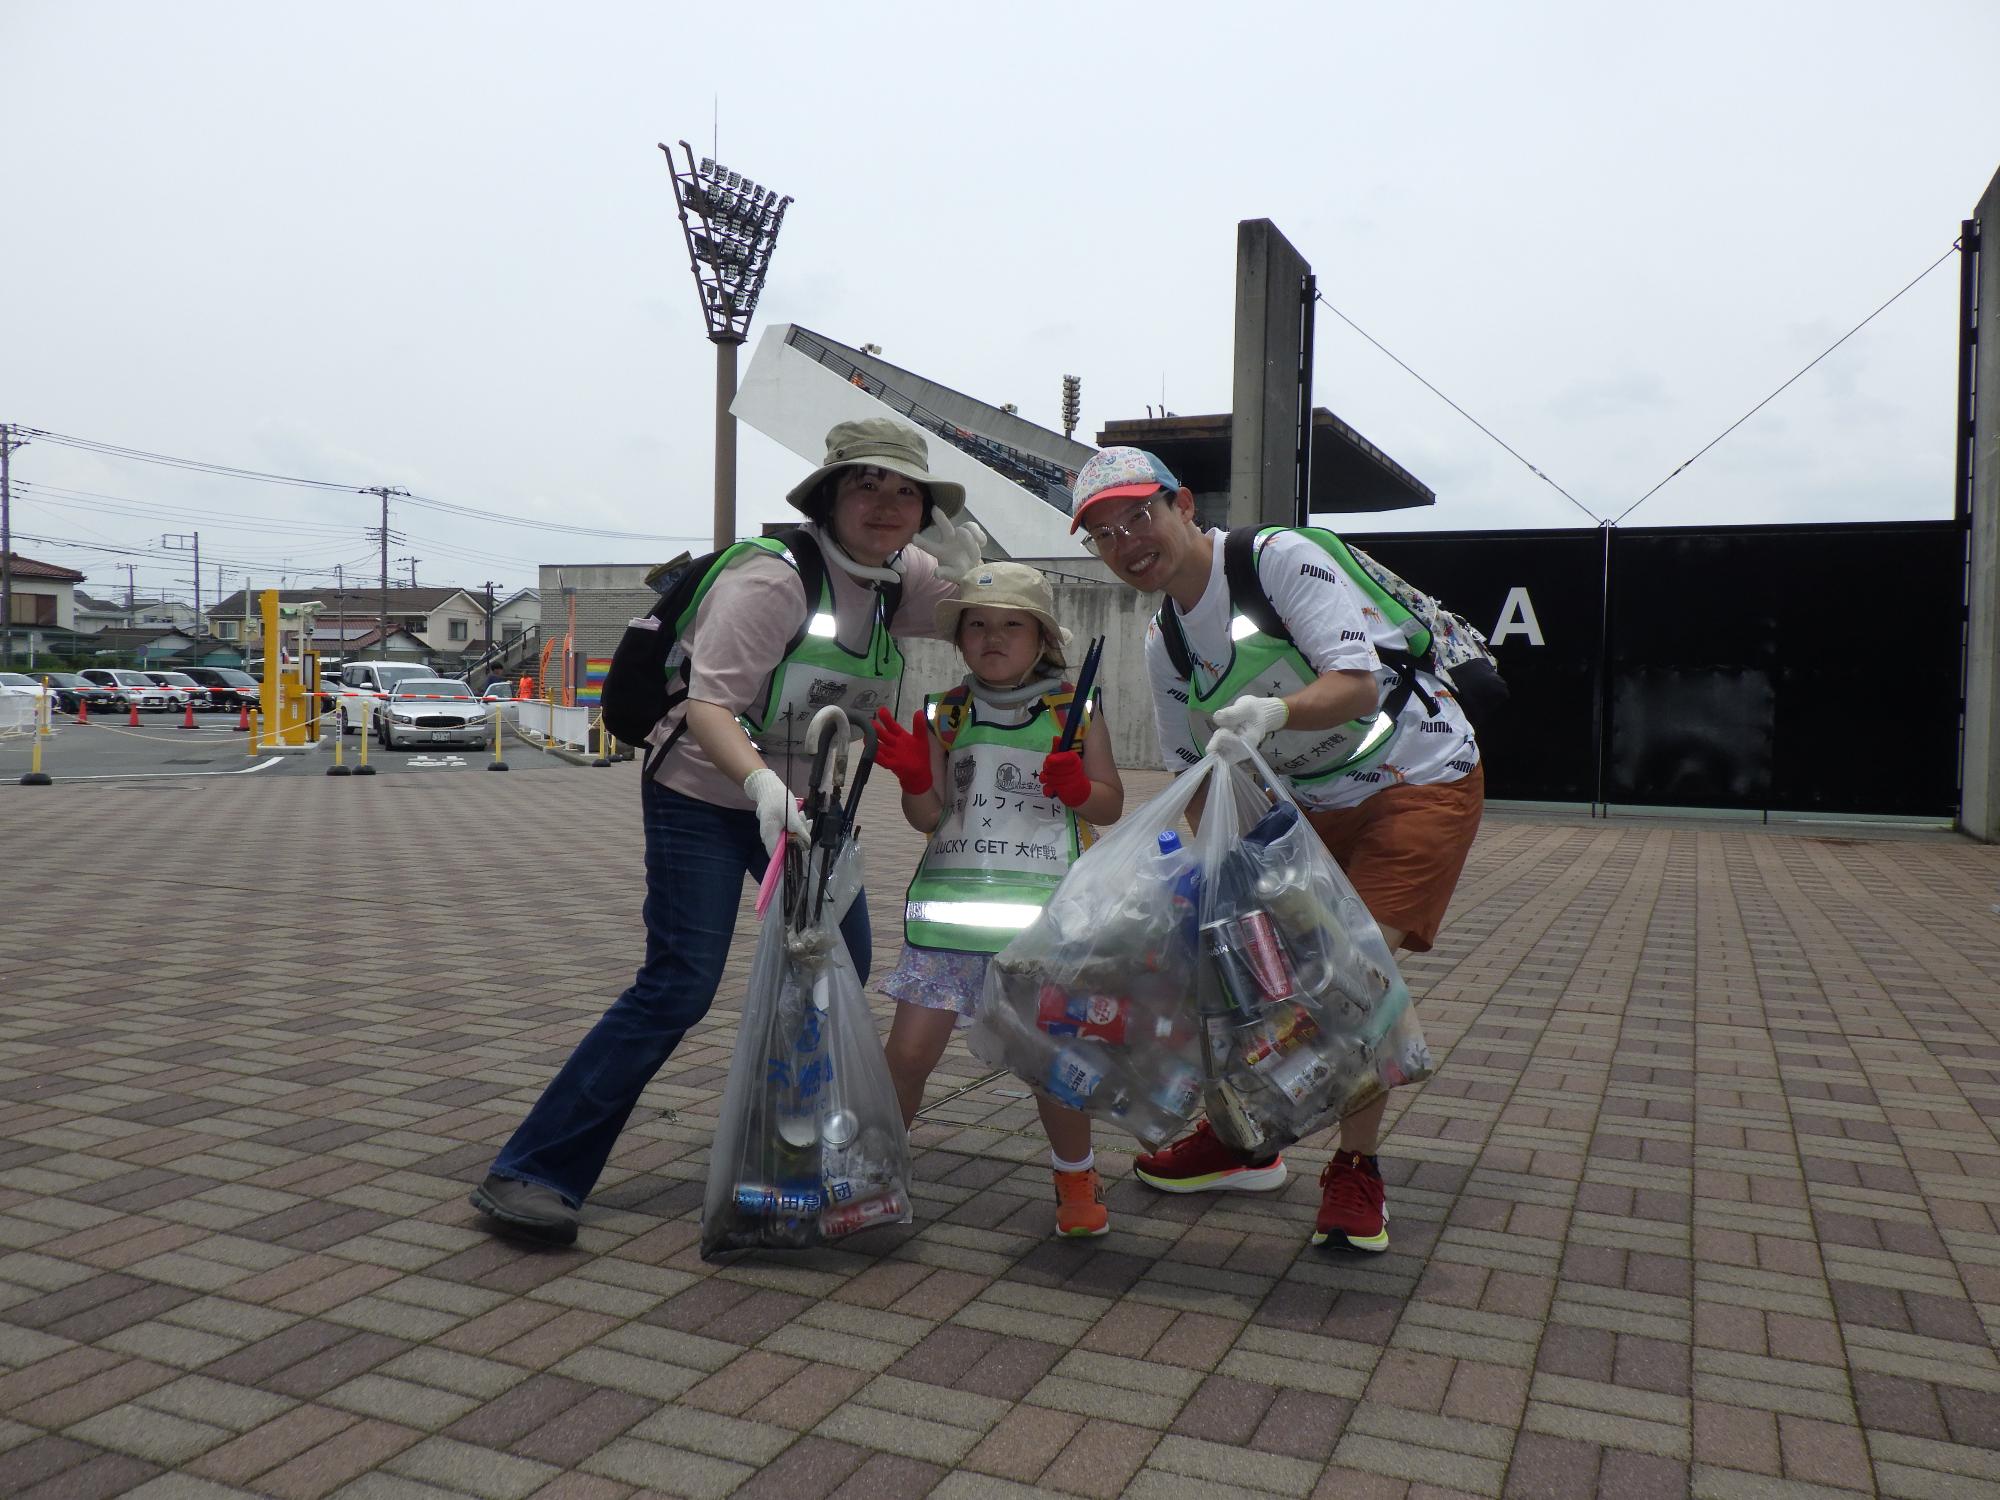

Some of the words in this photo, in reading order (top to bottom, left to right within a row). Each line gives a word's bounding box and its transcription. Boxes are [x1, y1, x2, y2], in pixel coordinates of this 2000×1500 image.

[1300, 563, 1336, 584] PUMA
[1489, 586, 1546, 647] A
[1420, 720, 1453, 734] PUMA
[1284, 754, 1310, 770] GET
[1346, 769, 1382, 784] PUMA
[935, 839, 968, 855] LUCKY
[975, 839, 1009, 855] GET
[1015, 842, 1057, 861] 大作戦
